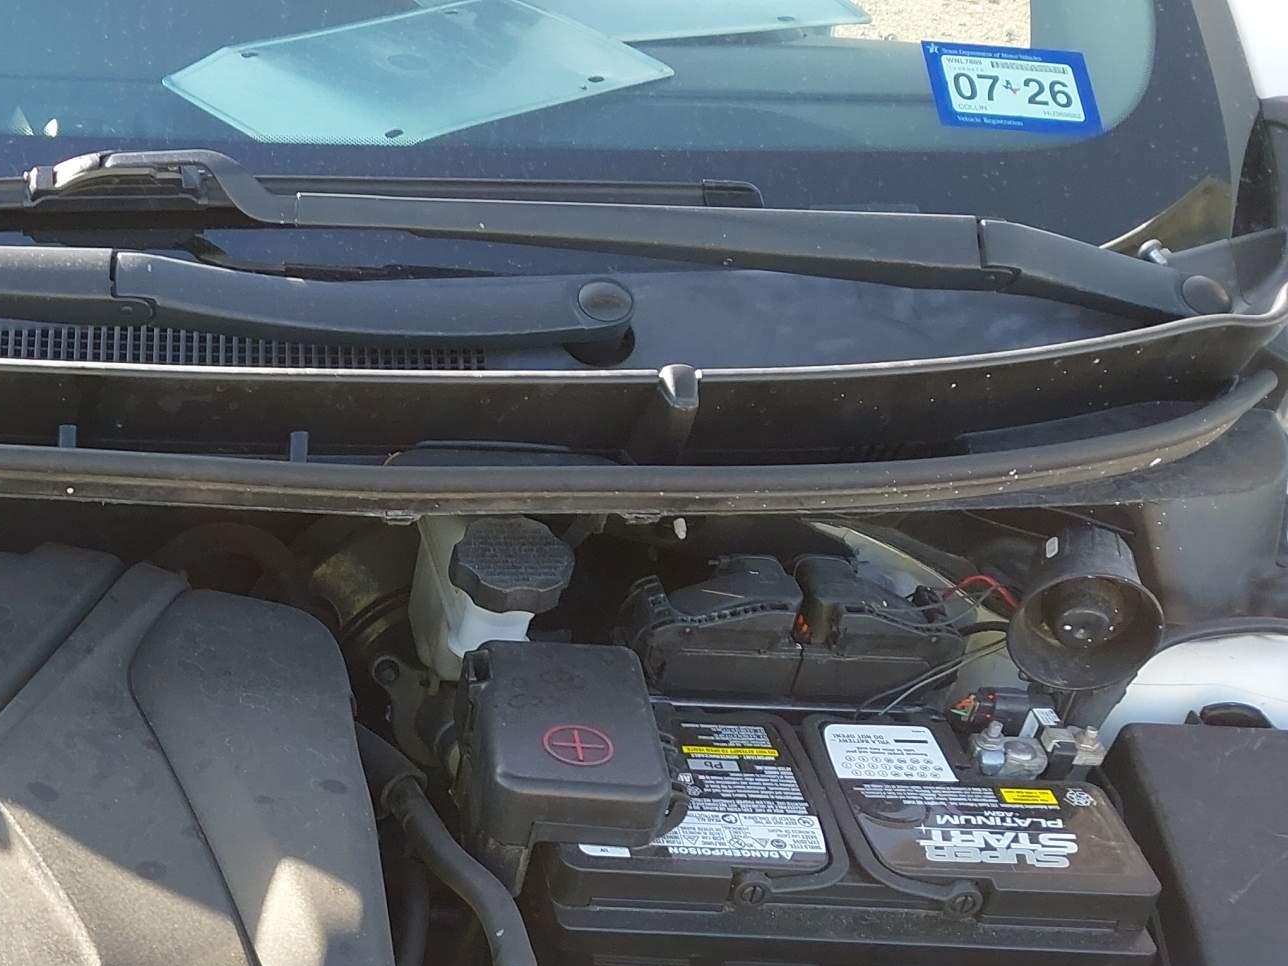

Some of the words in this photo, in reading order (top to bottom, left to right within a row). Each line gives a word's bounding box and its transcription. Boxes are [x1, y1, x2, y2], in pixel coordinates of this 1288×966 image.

[953, 72, 1000, 102] 07
[1023, 78, 1073, 108] 26
[704, 760, 724, 770] Pb
[936, 814, 1064, 829] PLATINUM
[918, 830, 1078, 854] START
[924, 845, 1070, 868] SUPER
